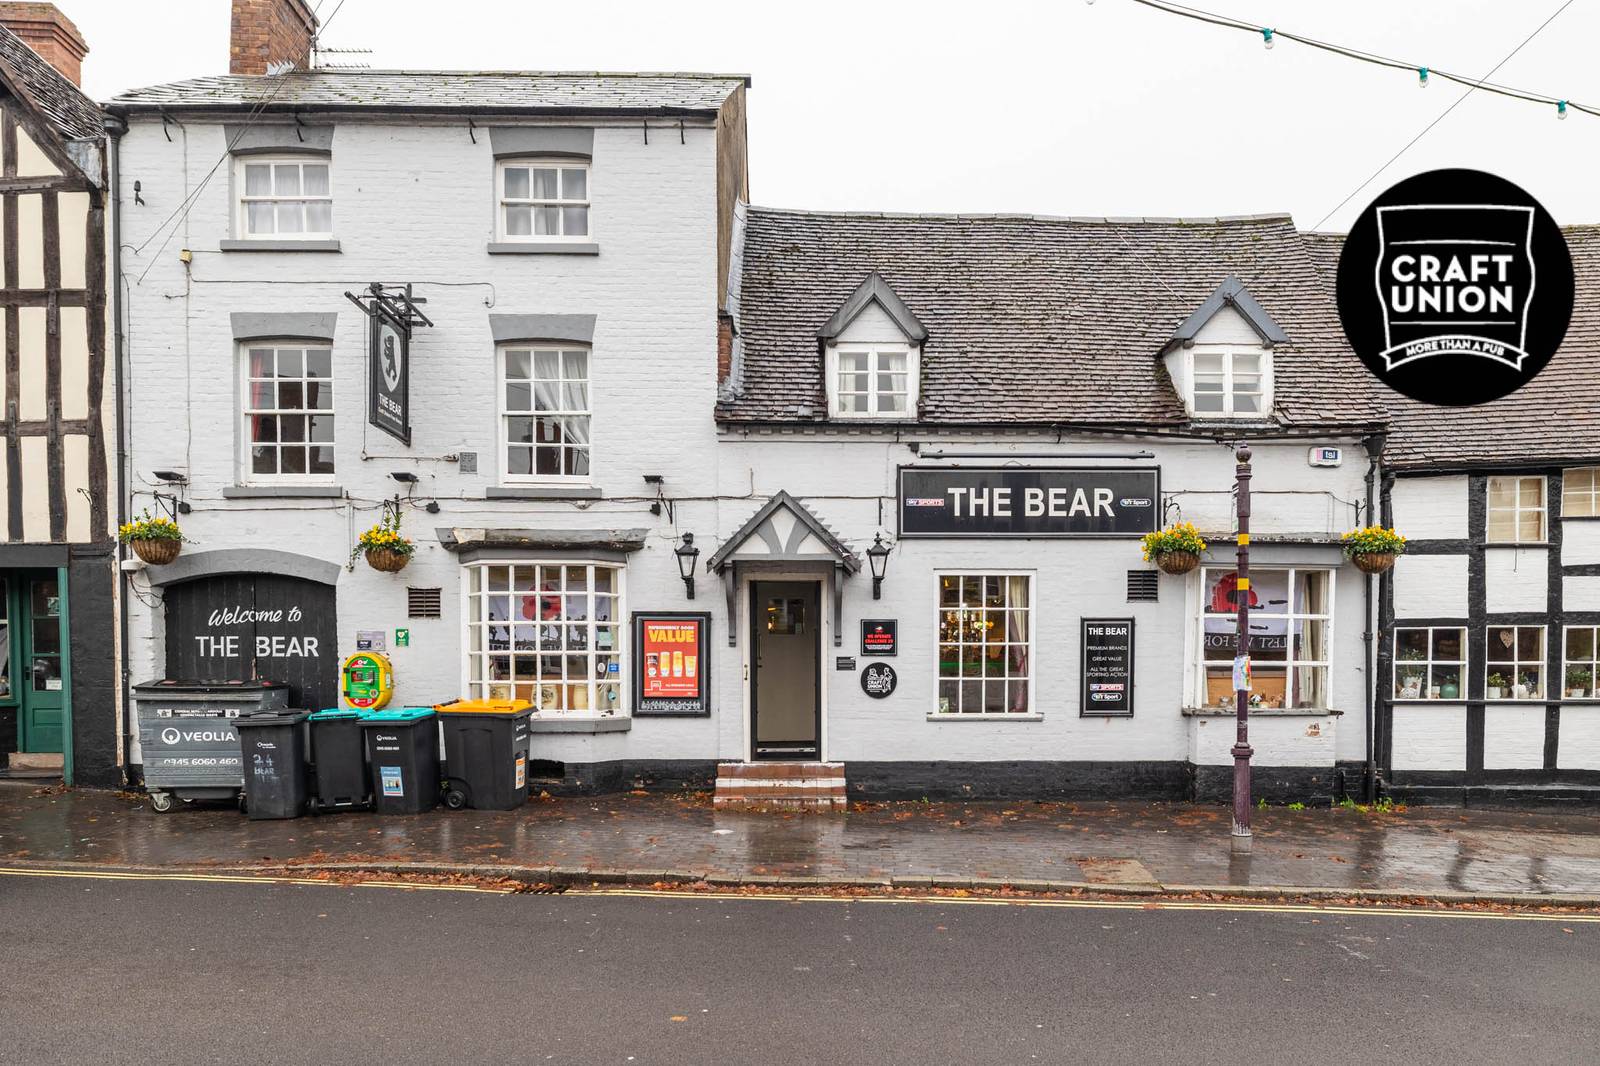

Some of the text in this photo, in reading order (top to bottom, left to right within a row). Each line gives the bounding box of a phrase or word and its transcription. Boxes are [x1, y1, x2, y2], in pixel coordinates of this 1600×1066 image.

[947, 487, 1116, 517] THE BEAR
[208, 605, 302, 627] Welcome to
[649, 630, 695, 642] VALUE
[1088, 627, 1127, 635] THE BEAR
[195, 636, 320, 657] THE BEAR
[182, 731, 236, 742] VEOLIA
[191, 758, 217, 766] 6060
